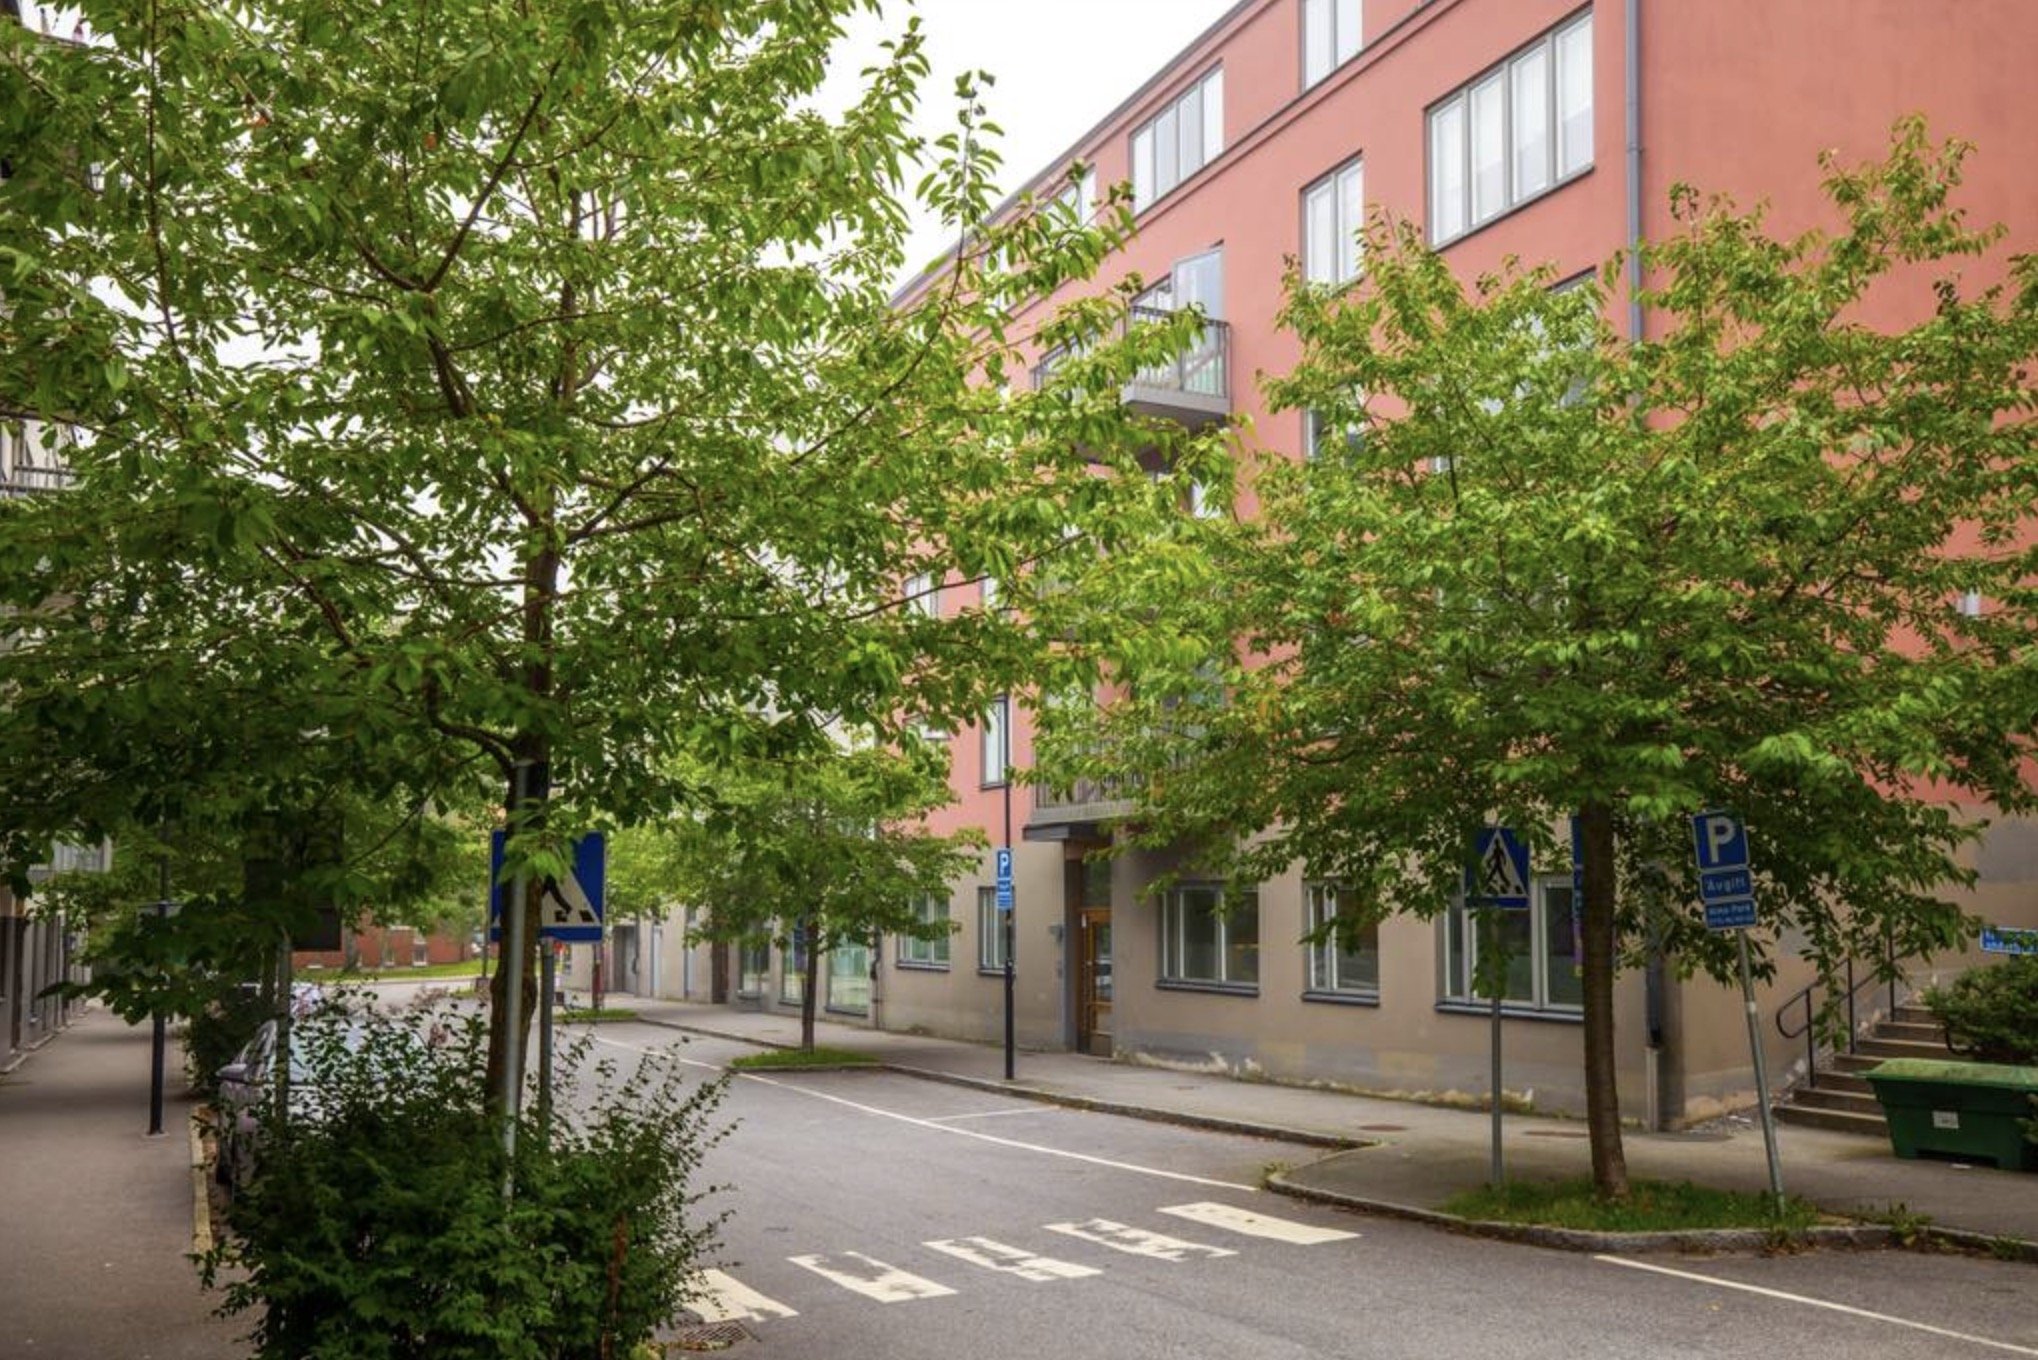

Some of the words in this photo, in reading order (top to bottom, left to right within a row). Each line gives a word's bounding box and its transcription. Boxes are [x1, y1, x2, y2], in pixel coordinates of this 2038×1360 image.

[1706, 816, 1736, 863] P
[1000, 853, 1009, 877] P
[1707, 877, 1746, 893] Avgift
